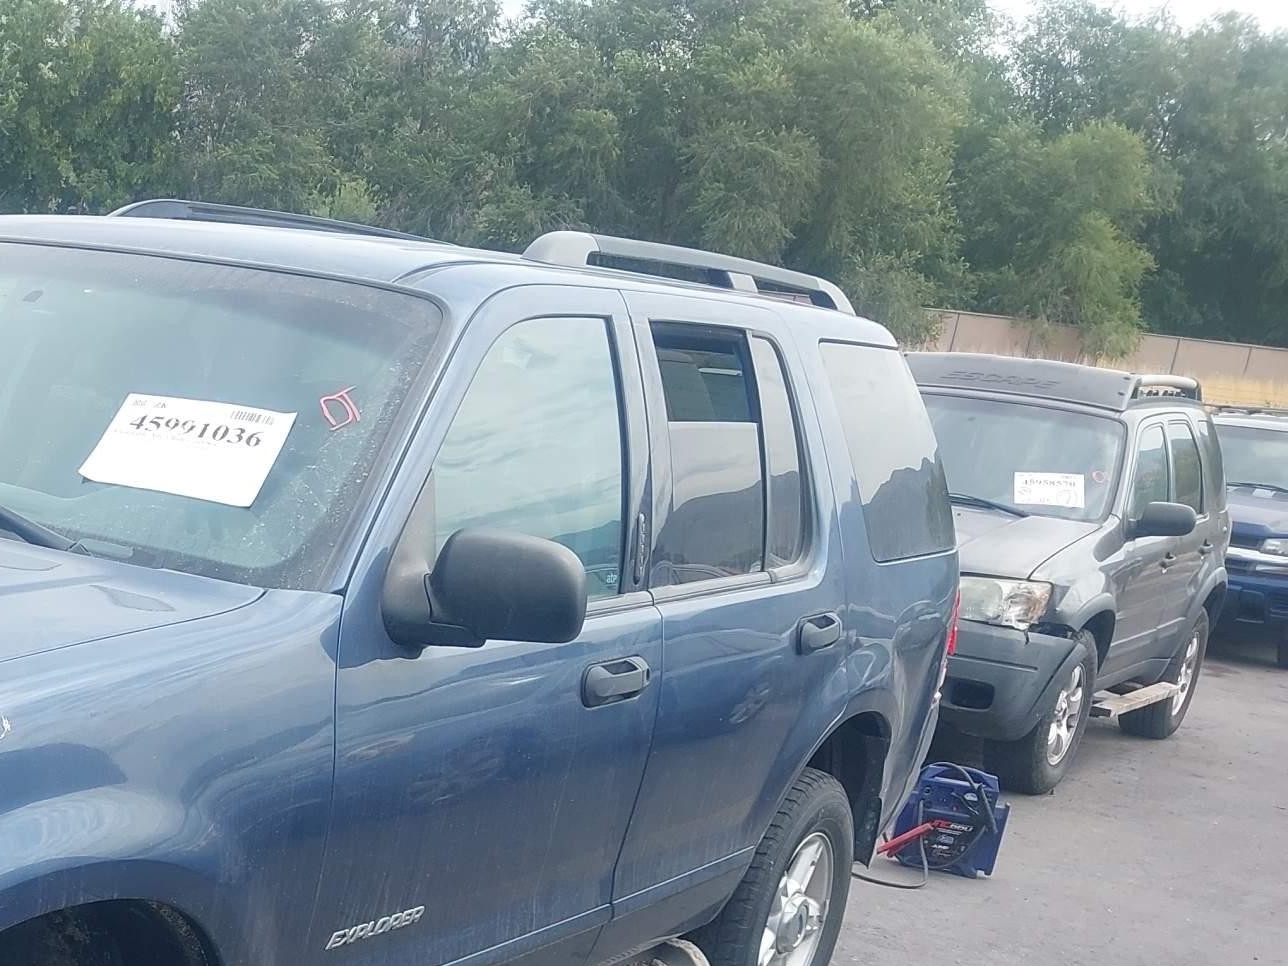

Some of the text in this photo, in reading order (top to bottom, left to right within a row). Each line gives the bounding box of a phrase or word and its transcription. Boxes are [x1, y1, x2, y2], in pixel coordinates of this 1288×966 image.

[940, 370, 1061, 389] ESCAPE
[128, 414, 264, 447] 45991036
[324, 905, 425, 951] EXPLORER
